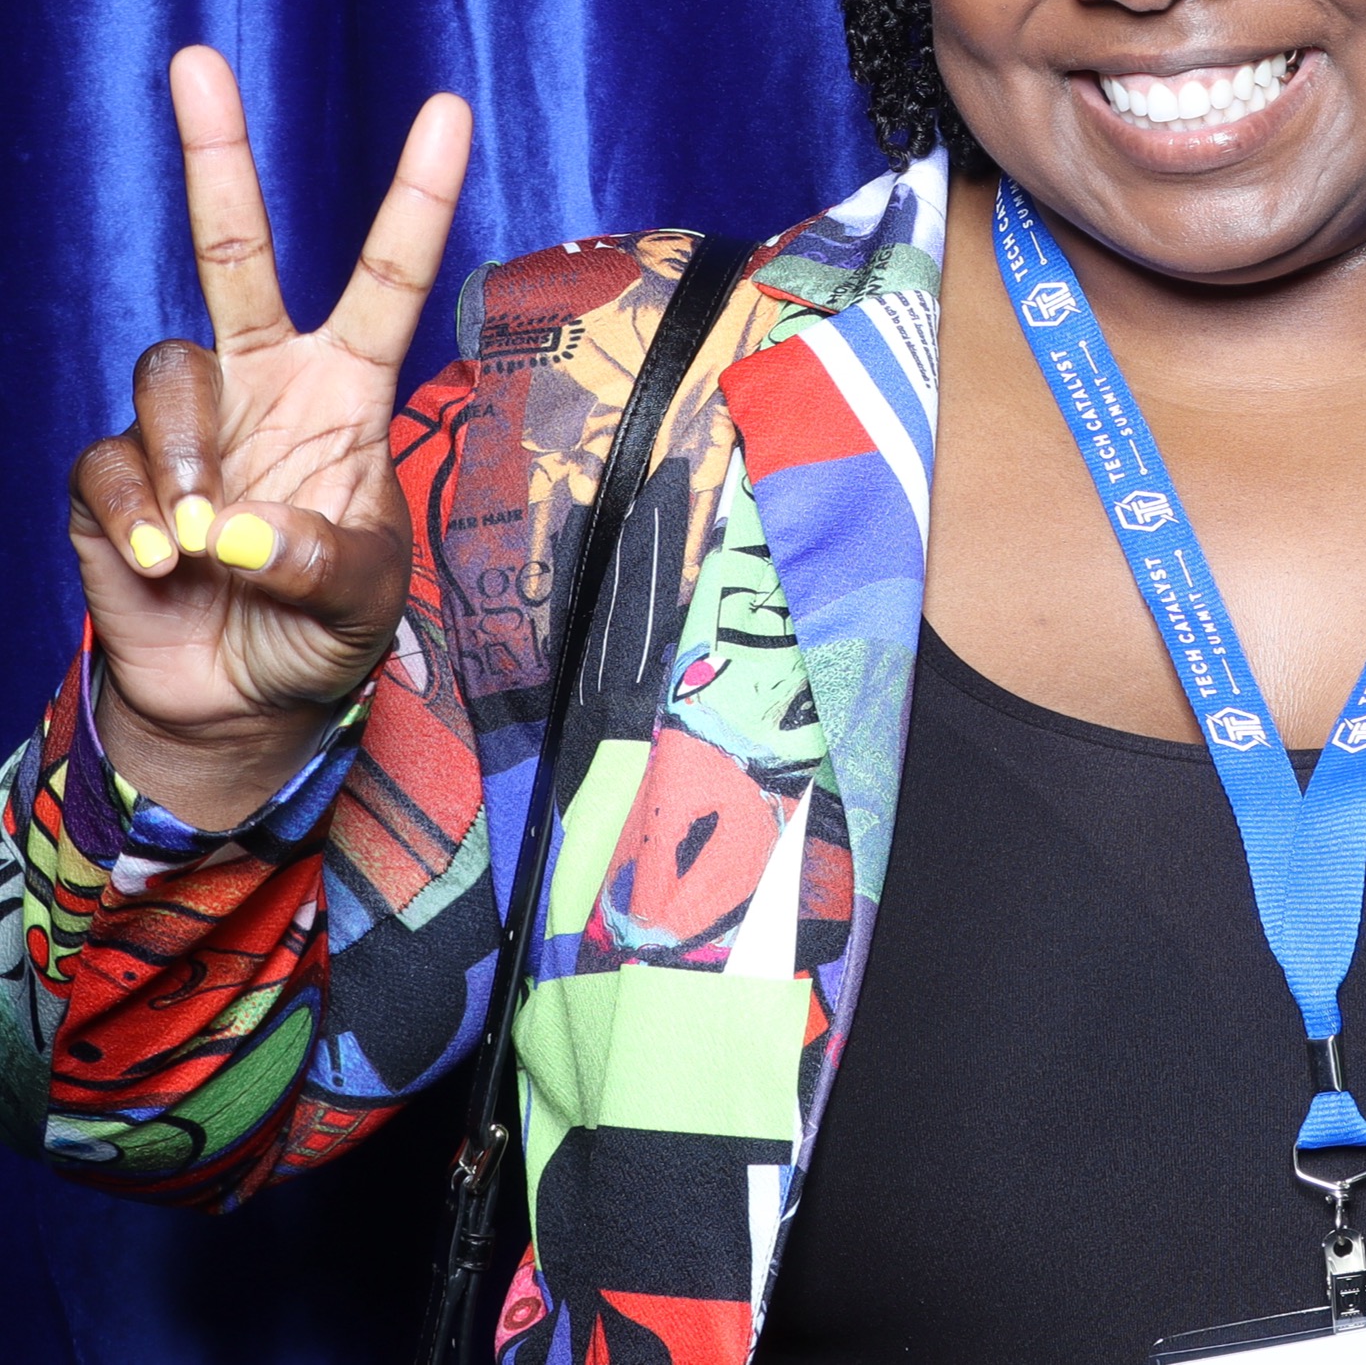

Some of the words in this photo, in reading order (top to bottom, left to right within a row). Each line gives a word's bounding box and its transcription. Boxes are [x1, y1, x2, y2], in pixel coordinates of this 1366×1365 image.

[1002, 233, 1028, 283] TECH
[1050, 350, 1103, 431] CATALYST
[1094, 377, 1134, 437] SUMMIT
[1092, 433, 1125, 484] TECH
[1144, 557, 1196, 644] CATALYST
[1188, 593, 1227, 655] SUMMIT
[1184, 649, 1218, 698] TECH
